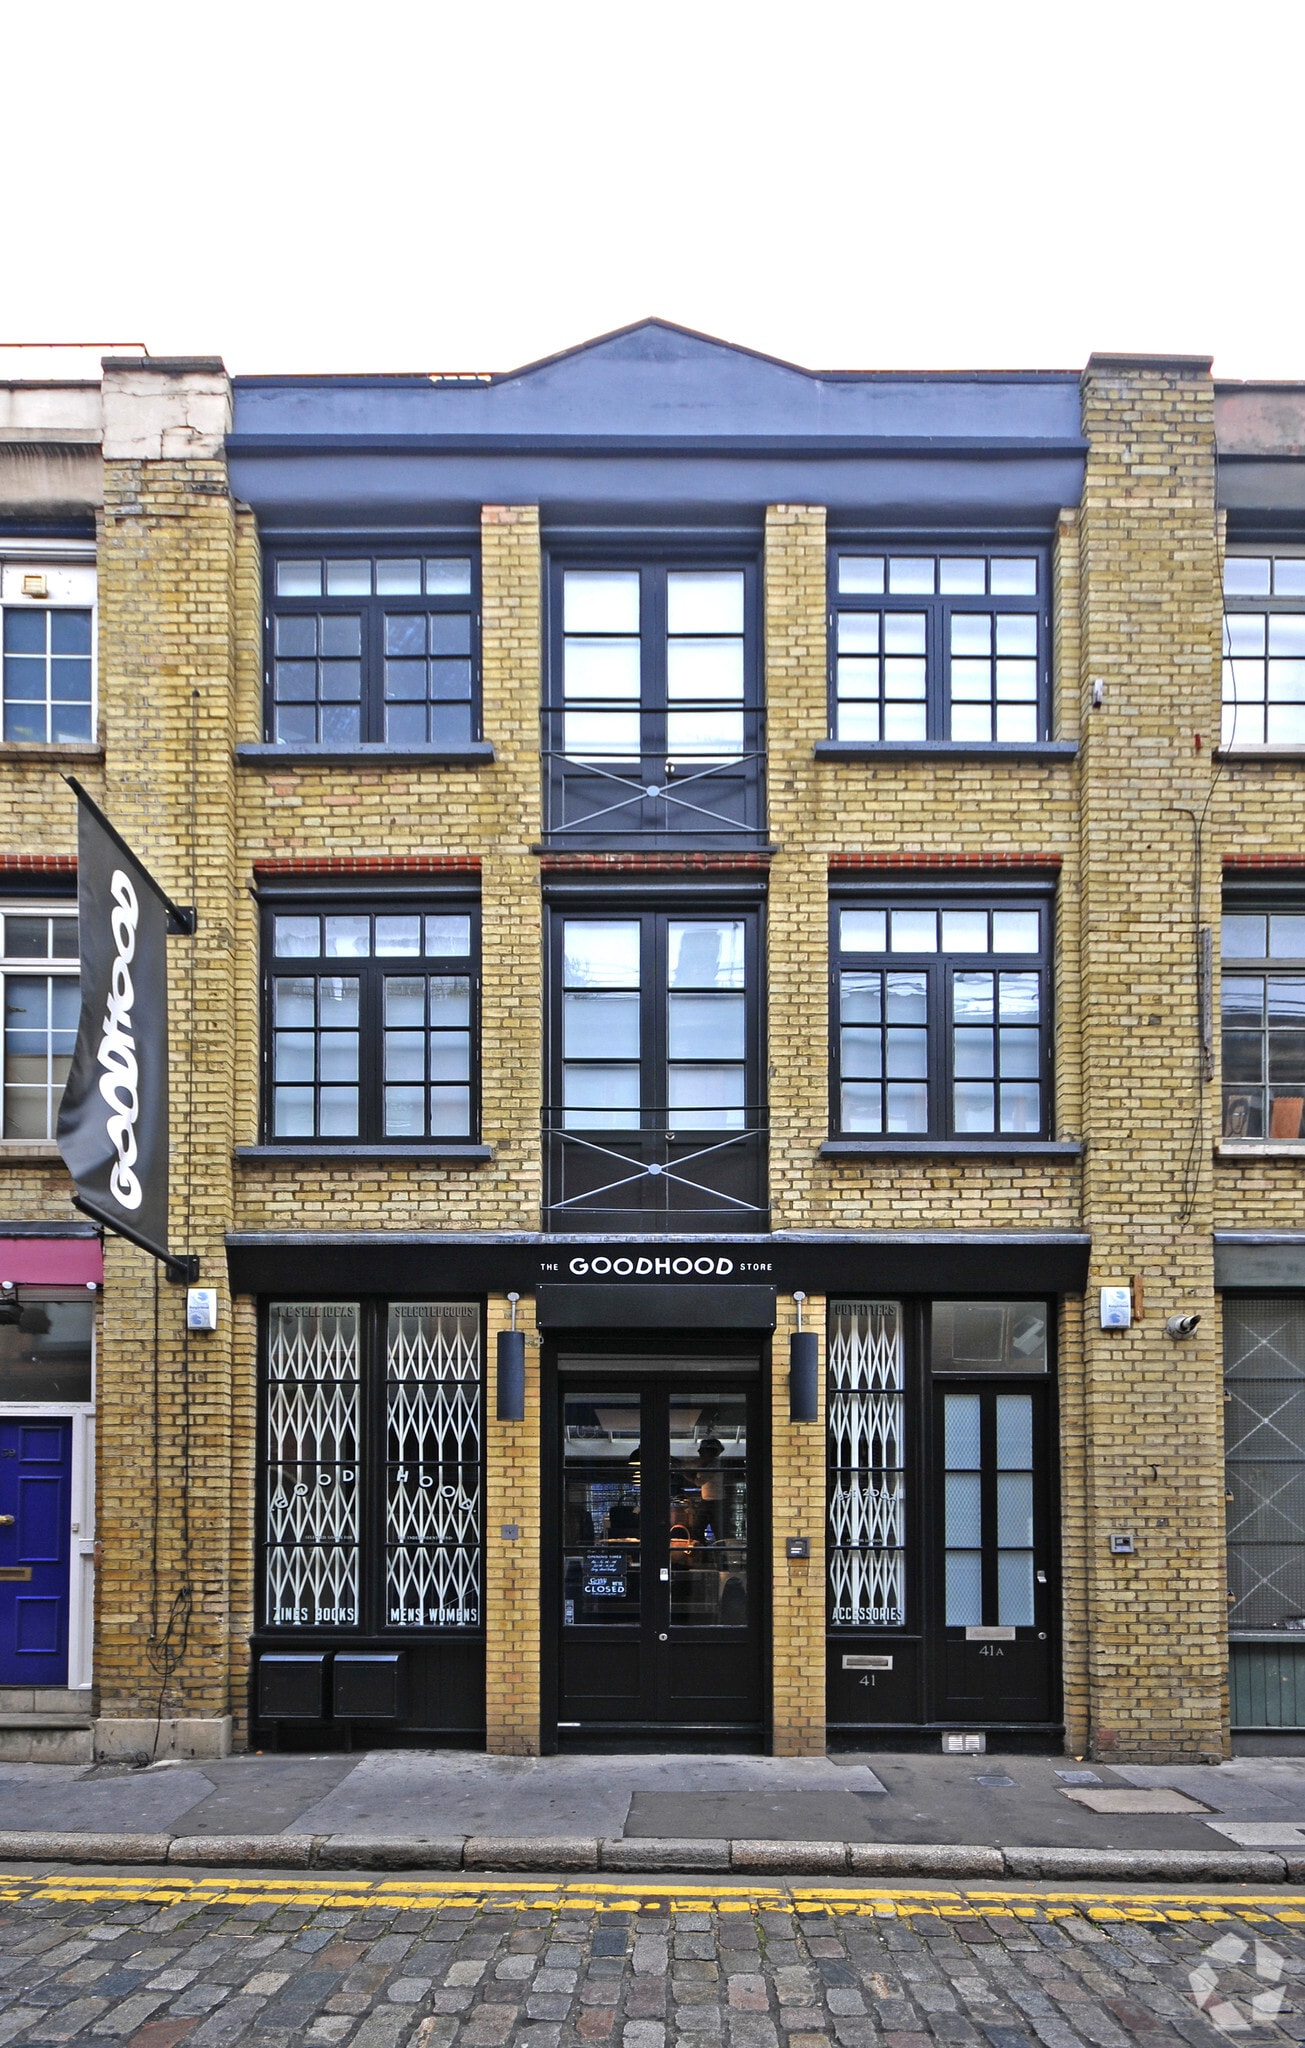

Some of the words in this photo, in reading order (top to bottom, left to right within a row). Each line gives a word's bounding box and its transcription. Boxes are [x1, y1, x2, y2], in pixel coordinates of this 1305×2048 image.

[97, 869, 142, 1211] GOODHOOD
[540, 1263, 559, 1271] THE
[569, 1256, 734, 1276] GOODHOOD
[739, 1262, 773, 1271] STORE
[323, 1306, 354, 1318] IDEAS
[394, 1306, 442, 1318] SELECTED
[443, 1306, 474, 1318] GOODS
[835, 1303, 898, 1316] OUTFITTERS
[584, 1585, 625, 1593] CLOSED
[273, 1607, 308, 1621] ZINES
[315, 1607, 354, 1621] BOOKS
[390, 1608, 422, 1622] MENS
[428, 1608, 477, 1622] WOMENS
[832, 1607, 903, 1620] ACCESSORIES
[979, 1645, 1004, 1656] 41A
[859, 1674, 875, 1686] 41
